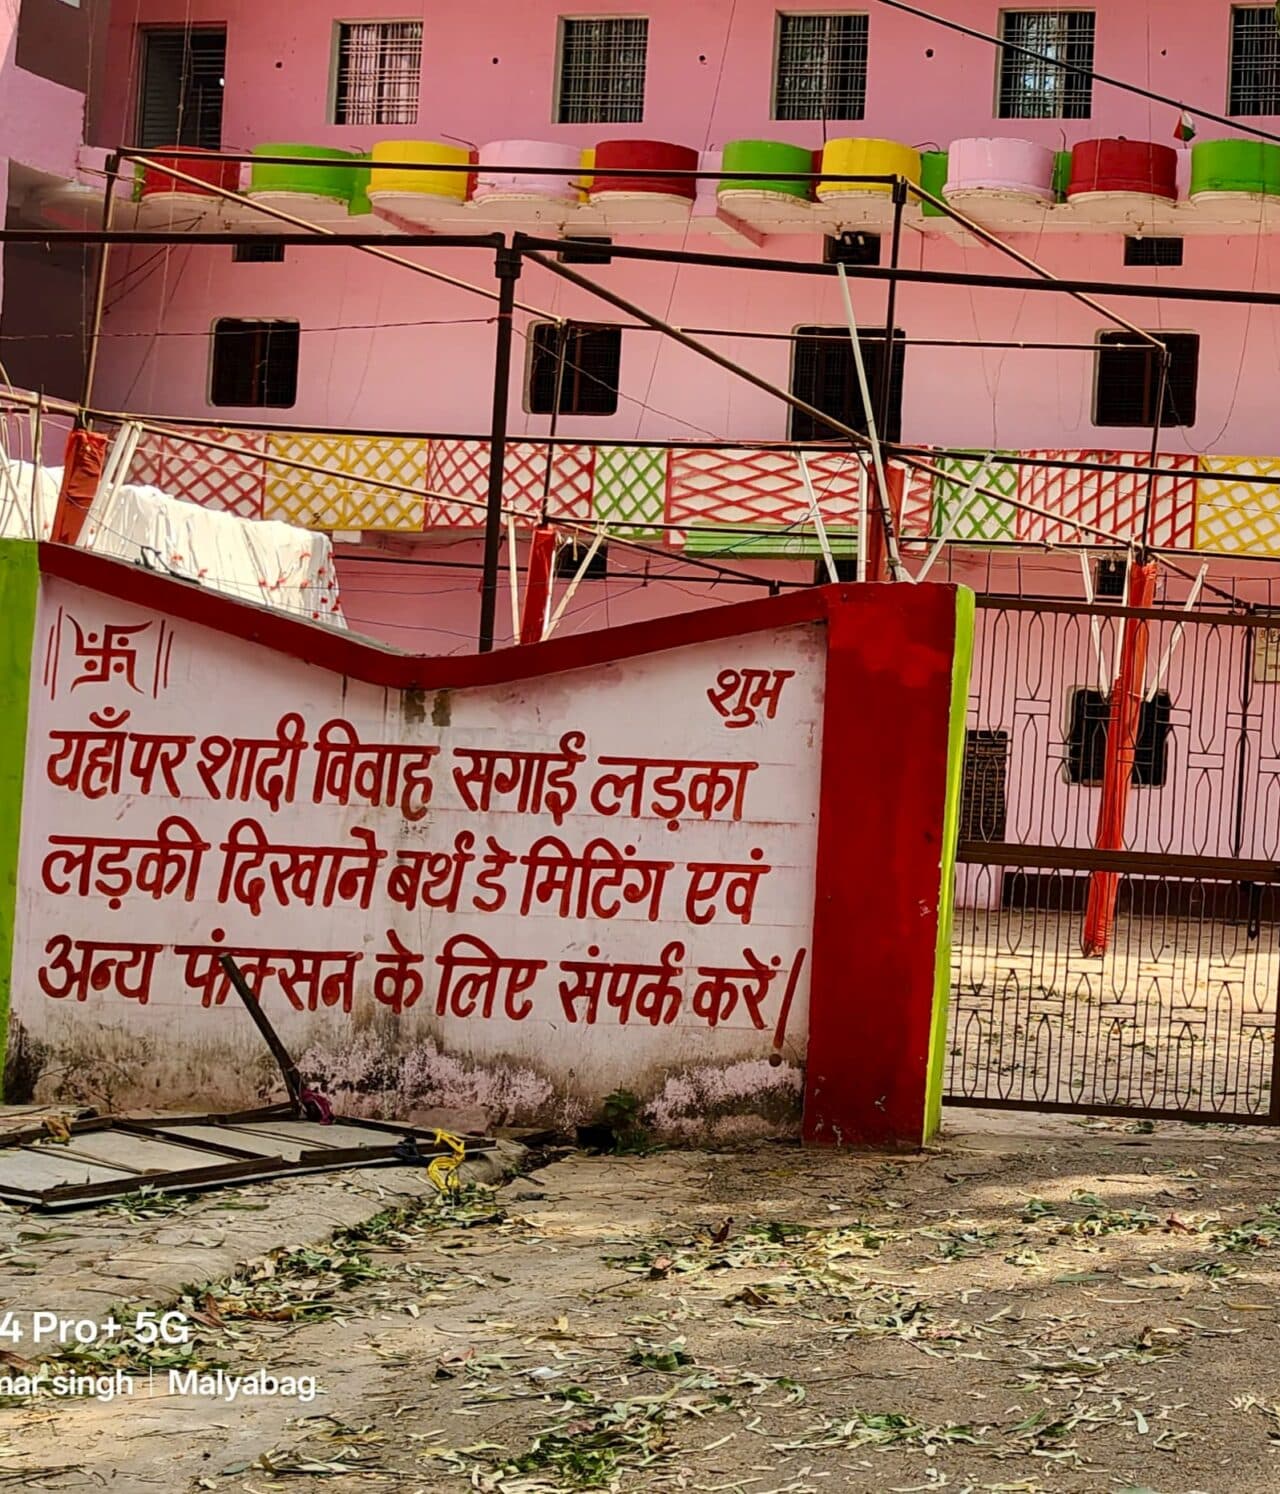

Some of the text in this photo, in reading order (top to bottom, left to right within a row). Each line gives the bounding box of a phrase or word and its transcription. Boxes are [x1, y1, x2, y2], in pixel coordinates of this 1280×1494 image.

[706, 667, 795, 729] शुभ
[47, 706, 759, 832] यहाँ पर शादी विवाह सगाई लड़का
[41, 816, 771, 925] लड़की दिखाने बर्थ डे मिटिंग एवं
[37, 935, 162, 1005] अन्य
[373, 929, 424, 1014] के
[435, 934, 548, 1020] लिए
[557, 942, 684, 1026] संपर्क
